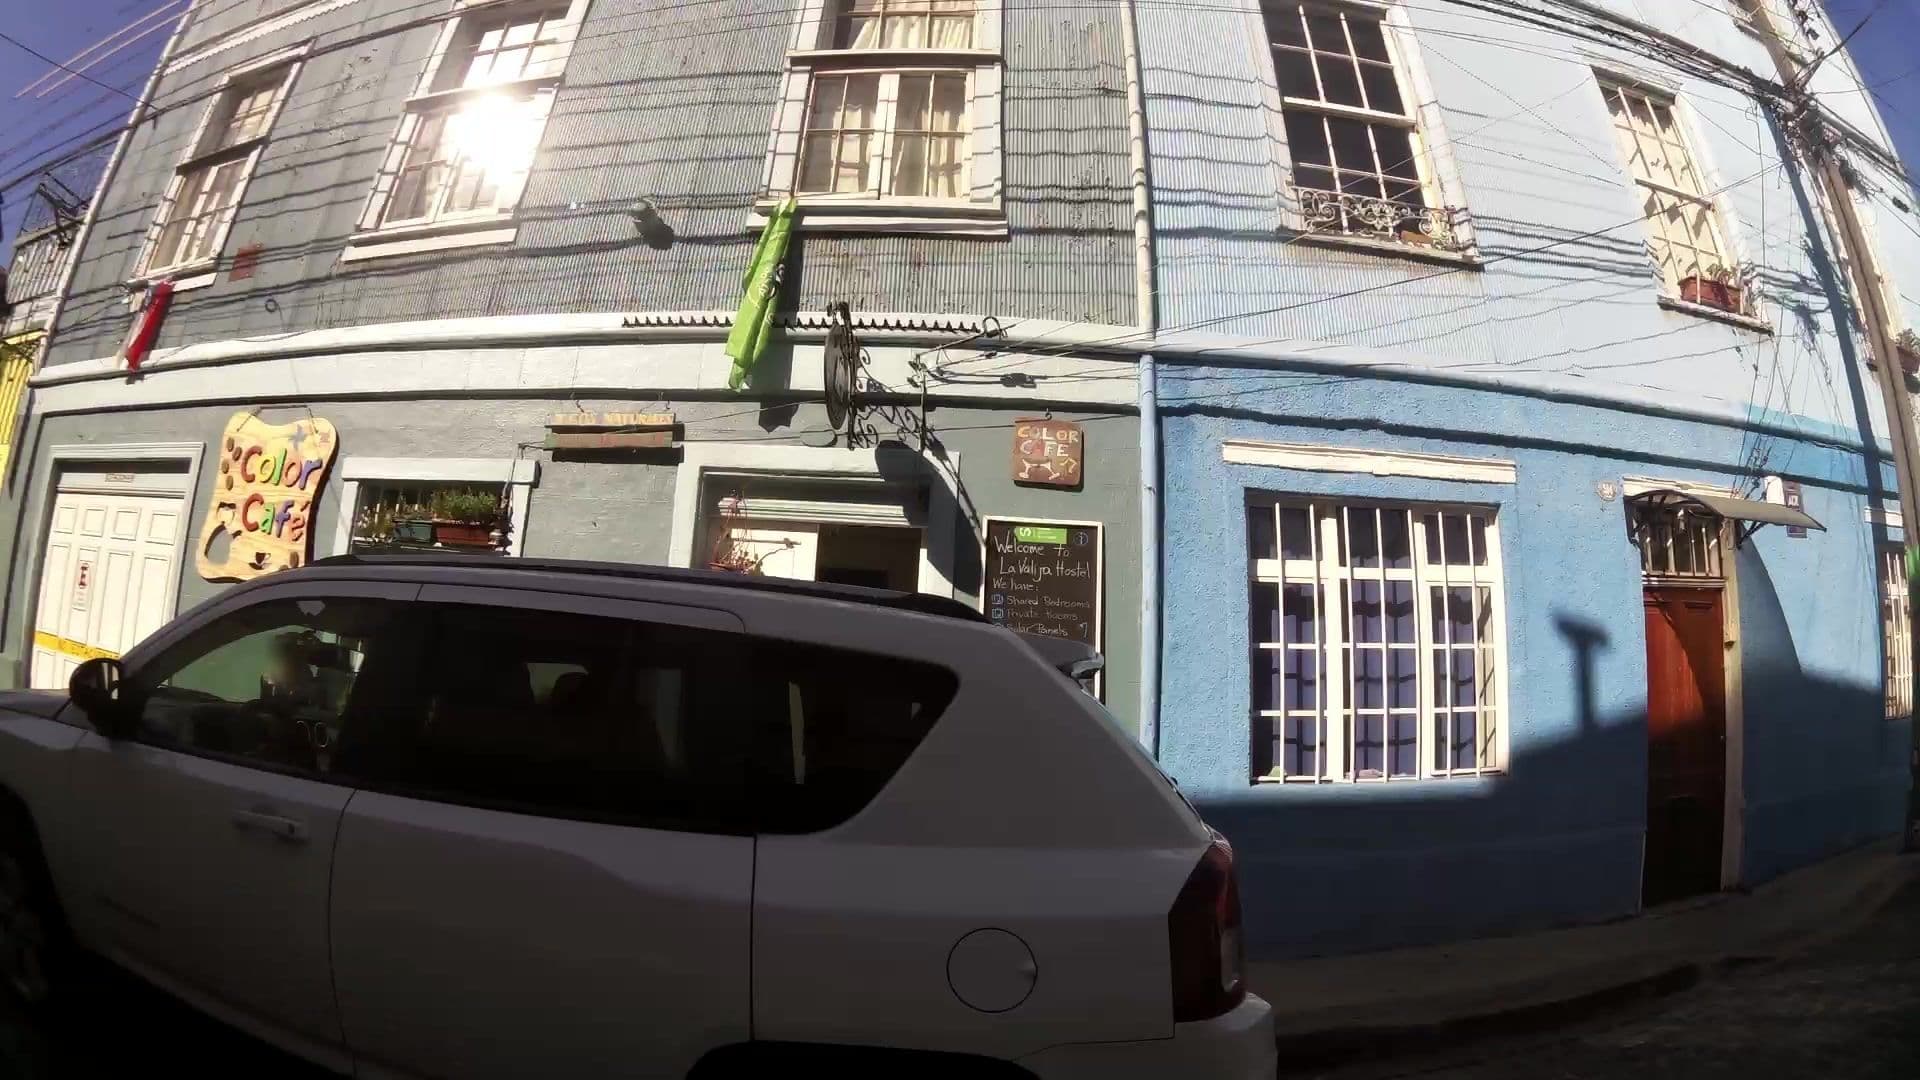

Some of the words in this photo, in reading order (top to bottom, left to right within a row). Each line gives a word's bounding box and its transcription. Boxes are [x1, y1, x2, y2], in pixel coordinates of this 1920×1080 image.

[1017, 425, 1079, 443] COLOR
[240, 445, 323, 490] Color
[241, 492, 311, 542] Café
[994, 530, 1044, 555] Welcome
[1000, 556, 1016, 575] La
[1055, 559, 1090, 578] Hostel
[992, 577, 1008, 589] We
[1007, 594, 1039, 606] Shared
